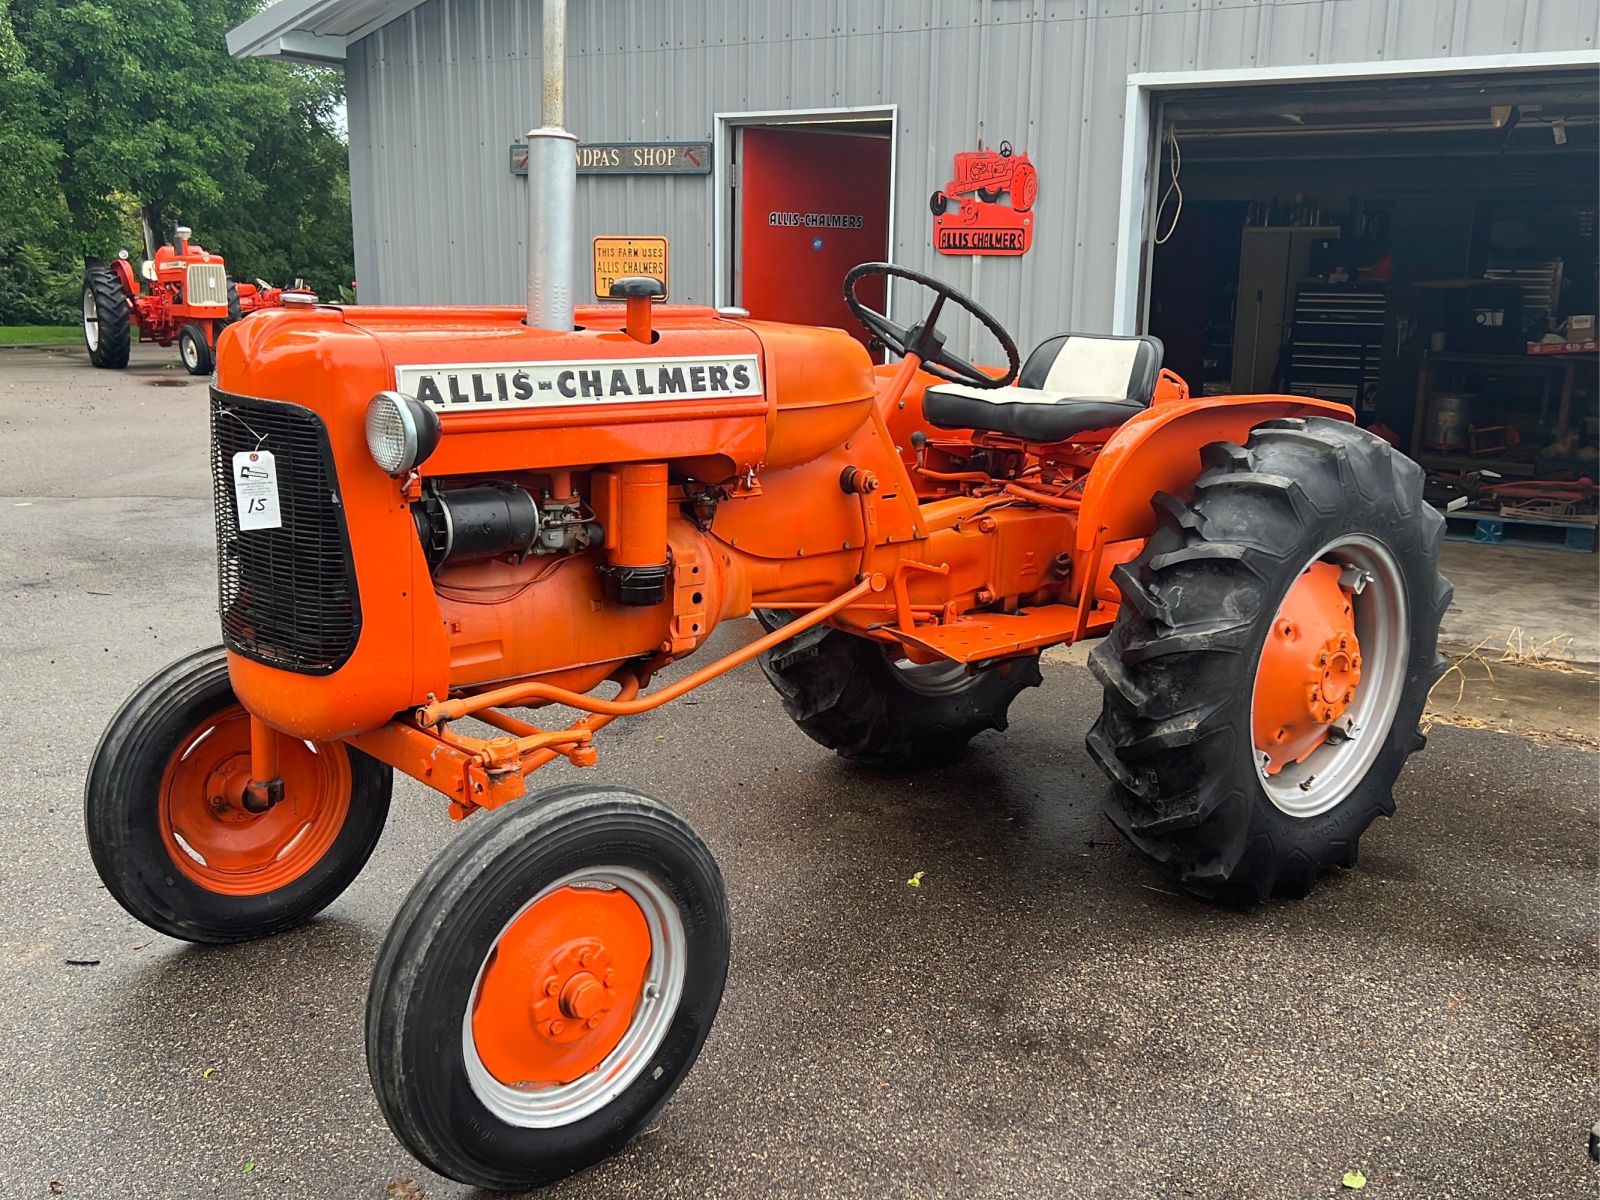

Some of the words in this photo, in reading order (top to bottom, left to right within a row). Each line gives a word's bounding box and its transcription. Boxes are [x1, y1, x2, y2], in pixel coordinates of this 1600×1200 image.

[576, 149, 620, 167] NDPAS
[634, 148, 676, 166] SHOP
[769, 212, 863, 228] ALLIS-CHALMERS
[941, 232, 969, 248] ALLIS
[972, 232, 1023, 250] CHALMERS
[597, 248, 615, 257] THIS
[618, 248, 639, 257] FARM
[642, 248, 663, 258] USES
[597, 262, 619, 274] ALLIS
[623, 262, 664, 274] CHALMERS
[415, 364, 751, 404] ALLIS-CHALMERS
[248, 498, 267, 514] 15
